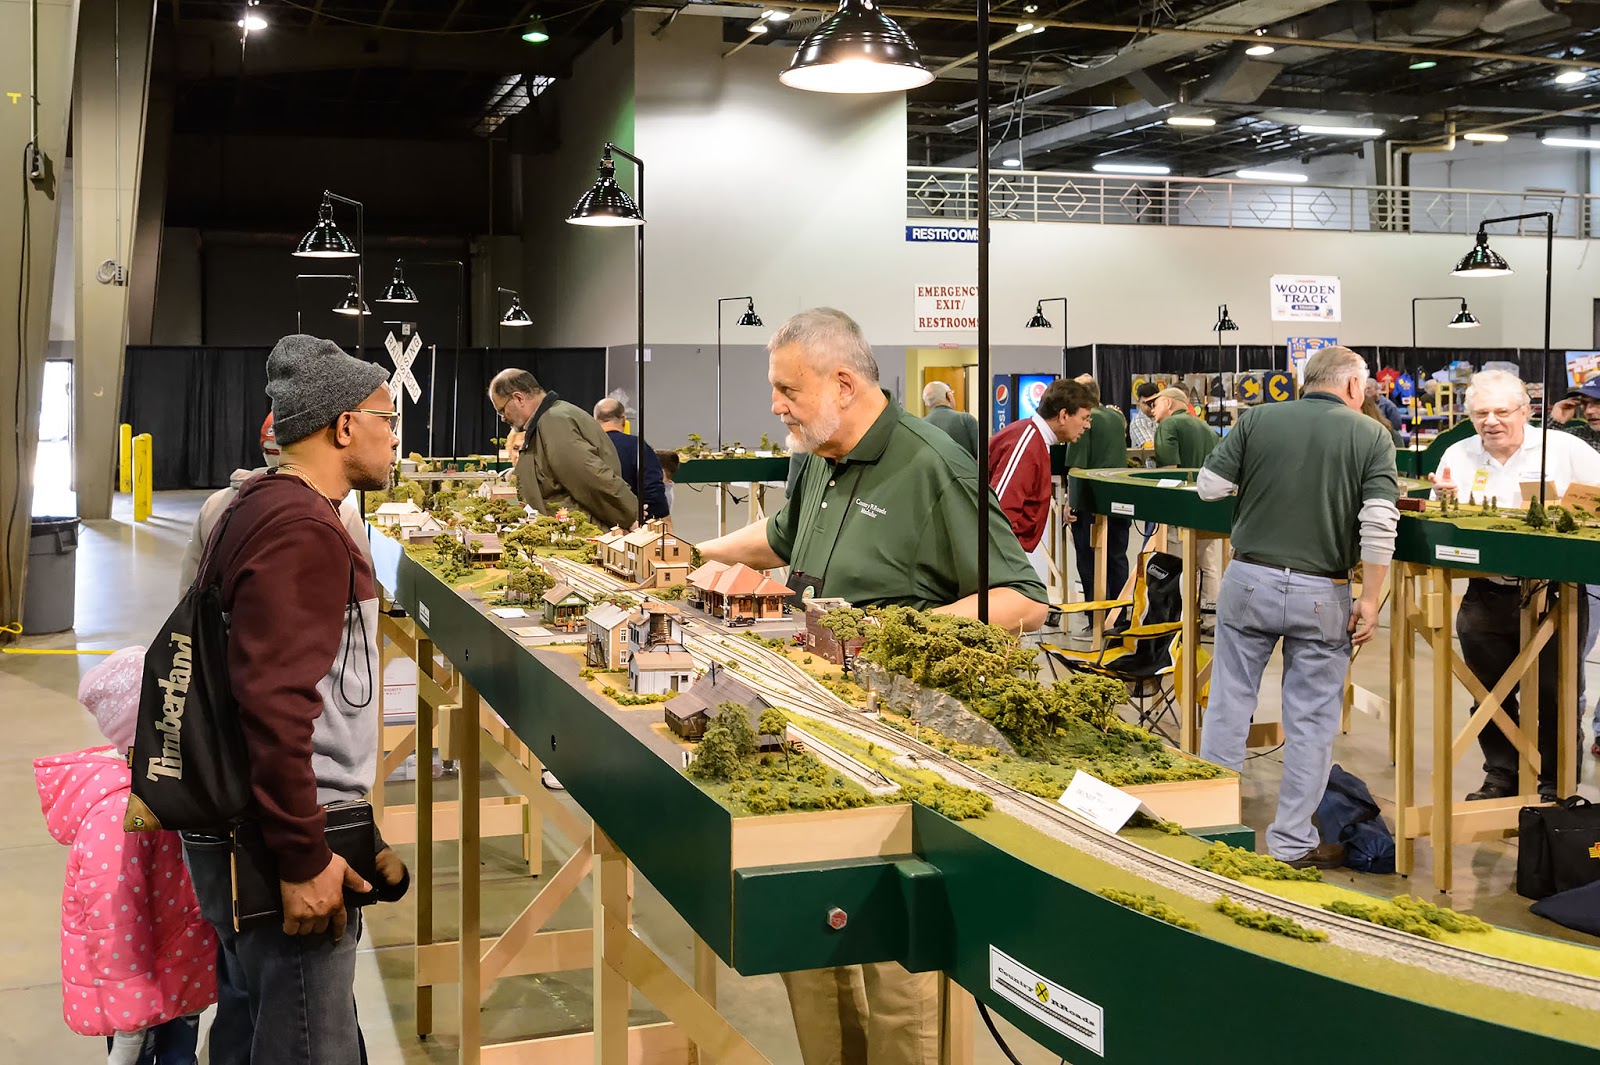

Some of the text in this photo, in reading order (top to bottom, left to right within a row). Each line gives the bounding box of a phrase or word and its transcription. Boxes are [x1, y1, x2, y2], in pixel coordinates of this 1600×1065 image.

[1275, 284, 1335, 294] WOODEN
[937, 299, 965, 311] EXIT/
[1283, 294, 1328, 304] TRACK
[405, 371, 419, 398] ROAD
[146, 632, 192, 782] Timberland
[998, 967, 1095, 1026] Country RRoads
